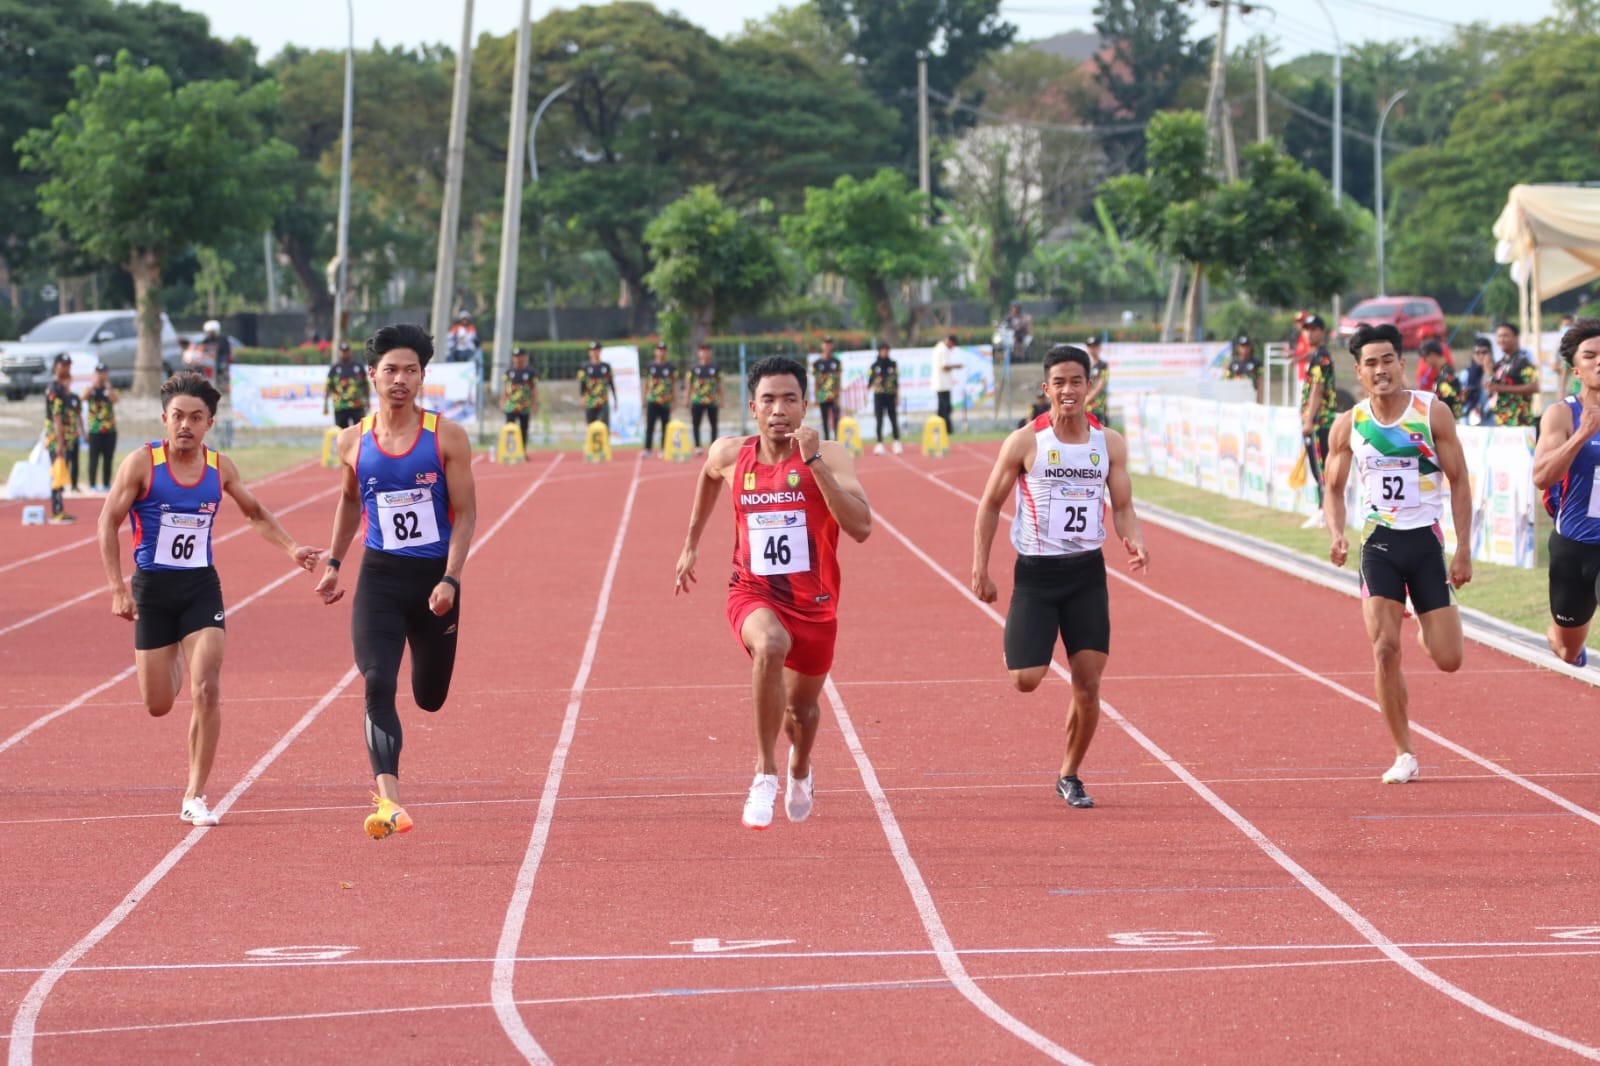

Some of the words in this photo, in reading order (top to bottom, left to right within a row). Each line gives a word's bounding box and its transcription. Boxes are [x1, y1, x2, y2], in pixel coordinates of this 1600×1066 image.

[592, 431, 603, 452] 5
[1045, 468, 1102, 479] INDONESIA
[740, 491, 806, 505] INDONESIA
[1382, 476, 1405, 500] 52
[393, 511, 422, 541] 82
[1063, 506, 1088, 533] 25
[171, 534, 196, 560] 66
[763, 534, 791, 566] 46
